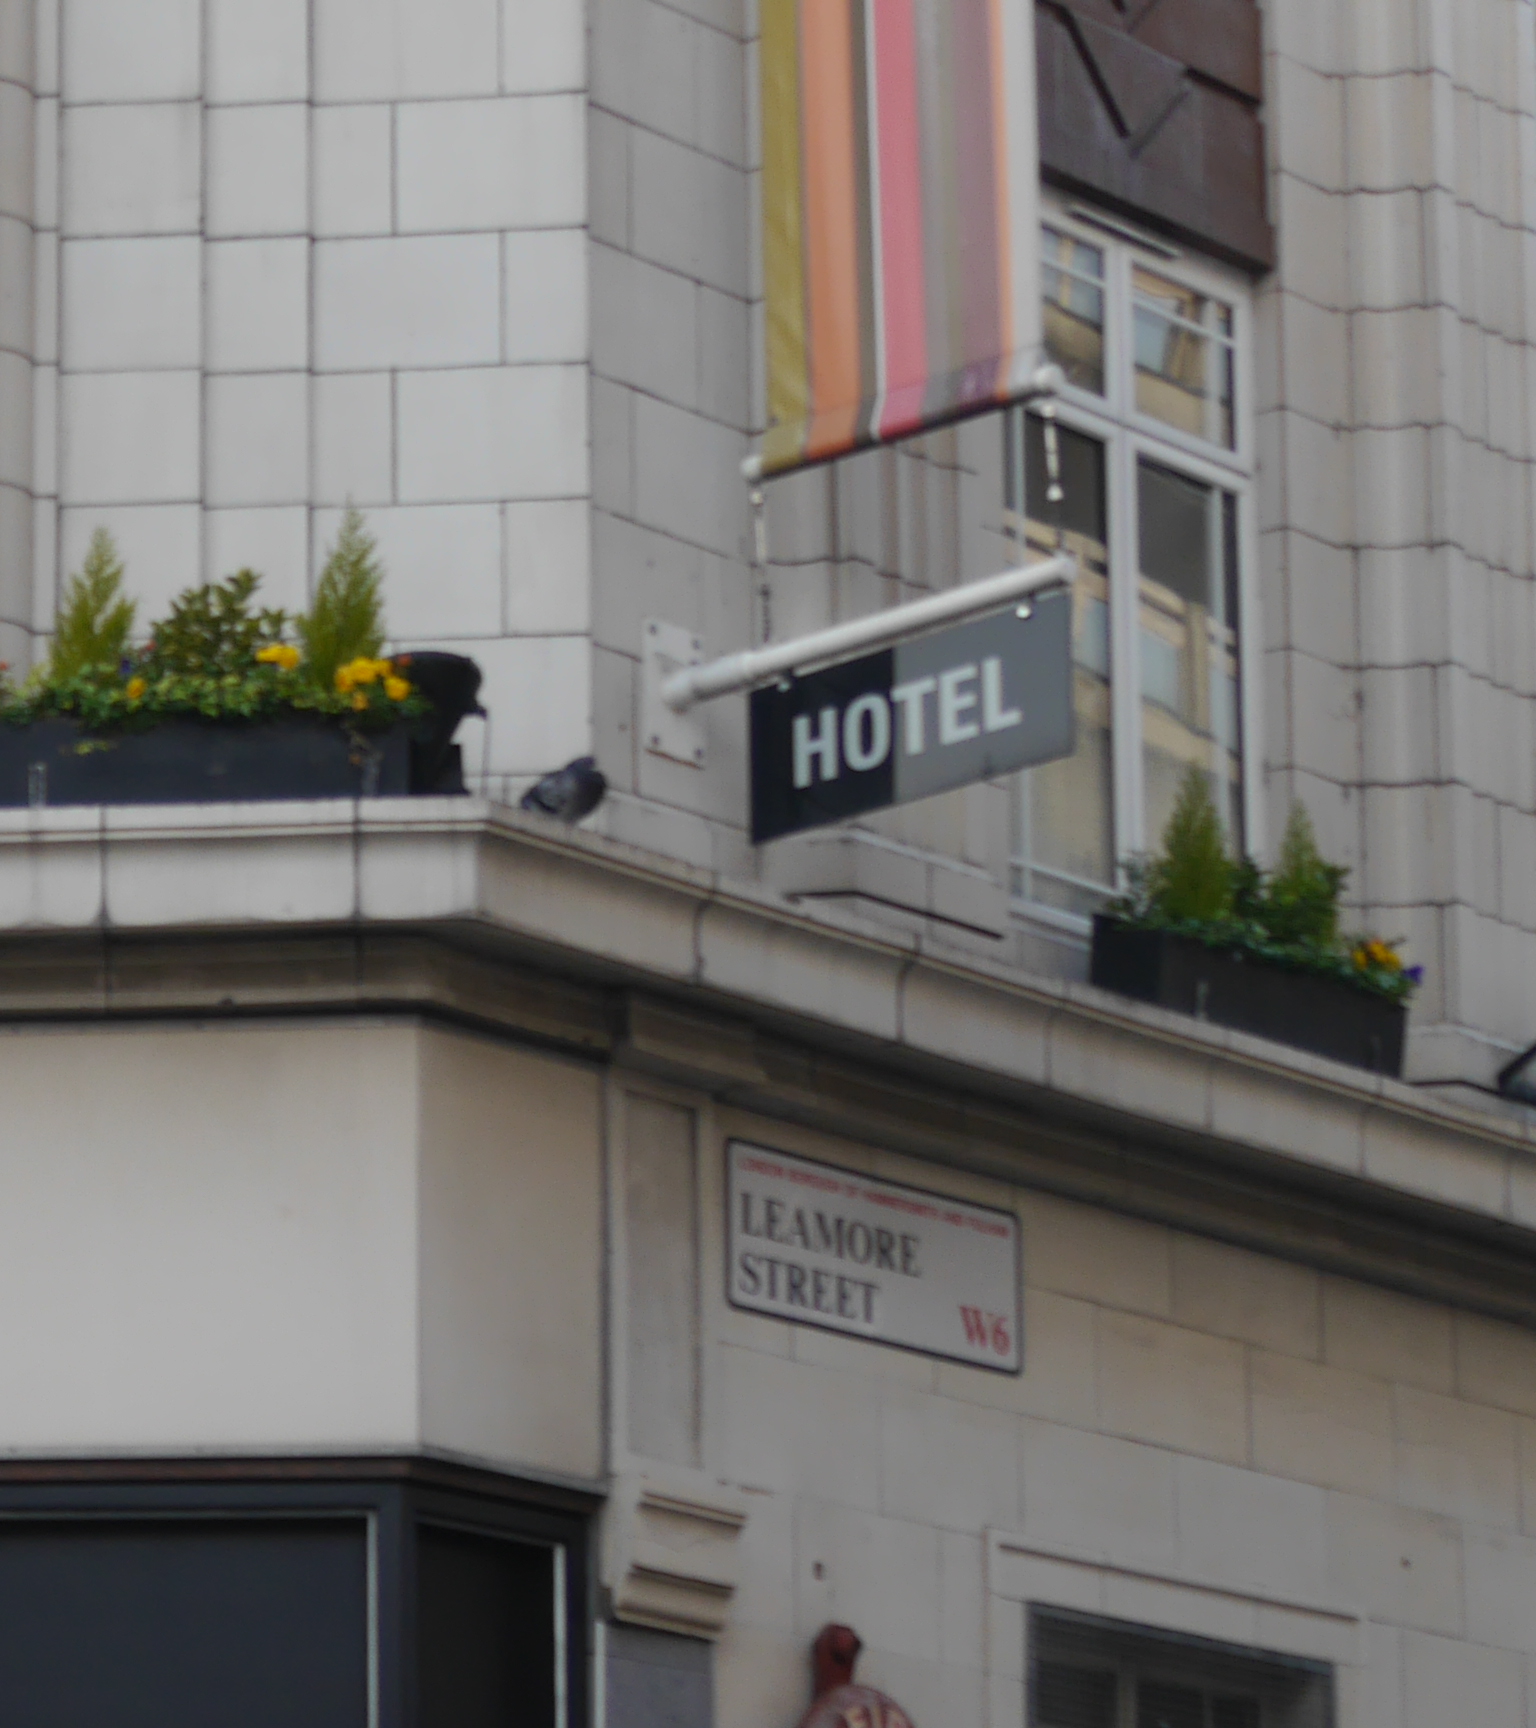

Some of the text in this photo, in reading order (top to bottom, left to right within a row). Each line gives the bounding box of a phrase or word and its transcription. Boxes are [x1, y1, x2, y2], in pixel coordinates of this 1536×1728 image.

[792, 657, 1021, 790] HOTEL
[740, 1192, 923, 1278] LEAMORE
[738, 1253, 879, 1324] STREET
[960, 1304, 1011, 1357] W6
